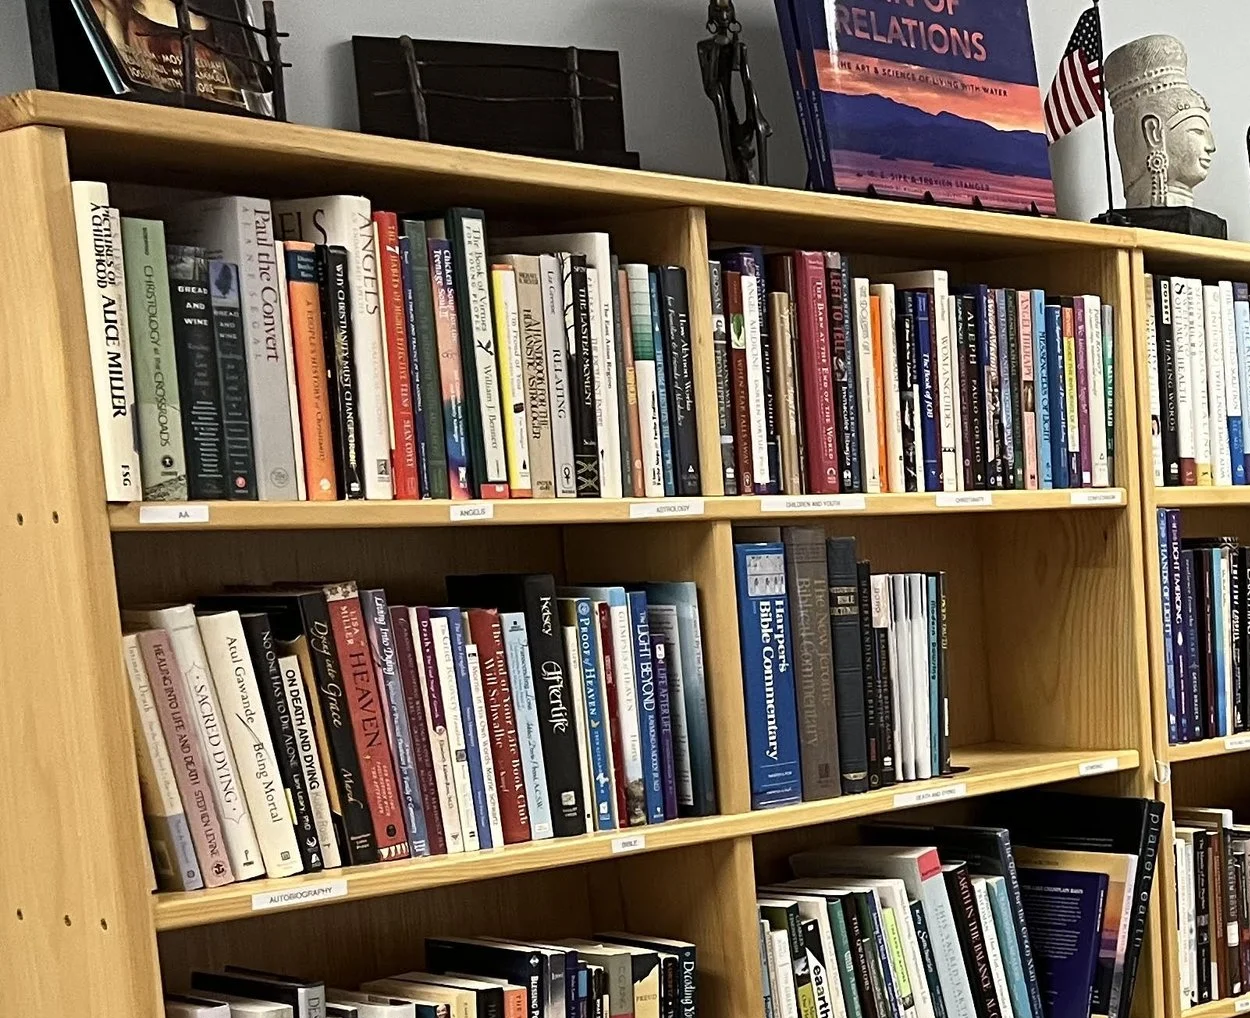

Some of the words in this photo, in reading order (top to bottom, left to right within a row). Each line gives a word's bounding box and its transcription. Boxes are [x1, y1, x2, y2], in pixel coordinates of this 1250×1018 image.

[836, 7, 987, 62] RELATIONS
[855, 63, 870, 72] ART
[874, 66, 879, 74] &
[882, 69, 915, 81] SCIENCE
[932, 77, 959, 89] LIVING
[982, 87, 1008, 97] WATER
[90, 202, 101, 212] A
[253, 209, 277, 246] Paul
[472, 227, 483, 248] The
[92, 215, 108, 288] CHILDHOOD
[258, 252, 275, 282] the
[357, 212, 380, 315] ANGELS
[474, 251, 485, 278] Book
[177, 285, 208, 294] BREAD
[477, 281, 486, 292] of
[830, 272, 841, 298] LEFT
[101, 295, 119, 347] ALICE
[183, 318, 209, 326] WINE
[260, 286, 280, 362] Convert
[478, 296, 489, 332] Virtues
[833, 305, 843, 321] TO
[1174, 295, 1183, 353] OPTIMUM
[834, 327, 845, 353] TELL
[107, 352, 127, 418] MILLER
[552, 348, 566, 420] RELATING
[967, 311, 977, 365] ALEPH
[973, 418, 982, 463] COELHO
[1176, 357, 1186, 403] HEALTH
[121, 464, 131, 486] FSG
[178, 511, 190, 519] AA
[459, 508, 486, 517] ANGELS
[656, 504, 690, 514] ASTROLOGY
[812, 500, 823, 508] AND
[1172, 542, 1180, 571] LIGHT
[373, 596, 389, 626] Living
[540, 596, 554, 637] Kelsey
[1174, 573, 1182, 624] EMERGING
[310, 620, 332, 657] Dying
[377, 627, 392, 646] Into
[758, 601, 772, 644] Bible
[773, 599, 790, 673] Harper's
[286, 670, 297, 687] ON
[322, 658, 336, 681] into
[379, 647, 395, 676] Dying
[288, 689, 305, 727] DEATH
[322, 682, 343, 729] Grace
[348, 652, 382, 748] HEAVEN
[540, 661, 569, 734] Afterlife
[761, 646, 780, 761] Commentary
[192, 684, 221, 748] SACRED
[213, 751, 239, 804] DYING
[226, 636, 242, 665] Atul
[235, 667, 256, 724] Gawande
[252, 742, 269, 778] Being
[262, 781, 281, 824] Mortal
[297, 728, 310, 753] AND
[303, 755, 320, 790] DYING
[340, 768, 364, 809] March
[621, 839, 638, 849] BIBLE
[1143, 813, 1161, 881] planet
[269, 886, 333, 905] AUTOBIOGRAPHY
[1133, 892, 1149, 949] earth
